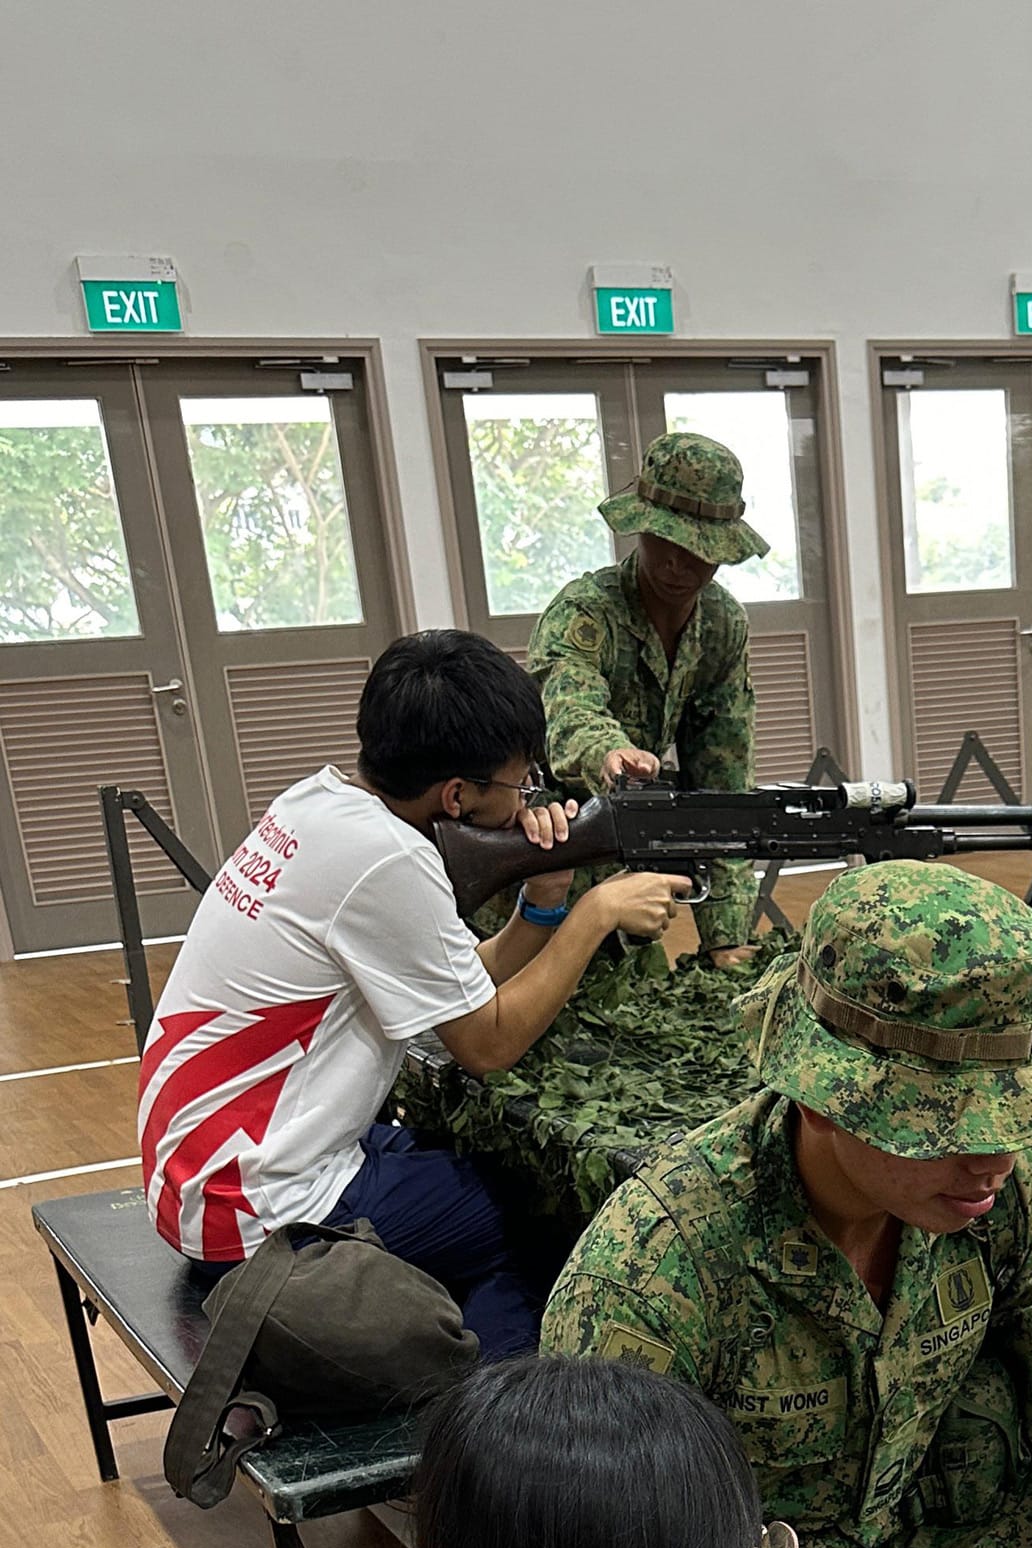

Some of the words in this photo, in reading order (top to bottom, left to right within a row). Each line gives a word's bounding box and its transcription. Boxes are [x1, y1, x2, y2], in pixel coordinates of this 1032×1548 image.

[102, 290, 159, 324] EXIT
[610, 296, 658, 327] EXIT
[239, 852, 283, 893] 2024
[215, 870, 264, 920] DEFENCE
[780, 1388, 829, 1414] WONG
